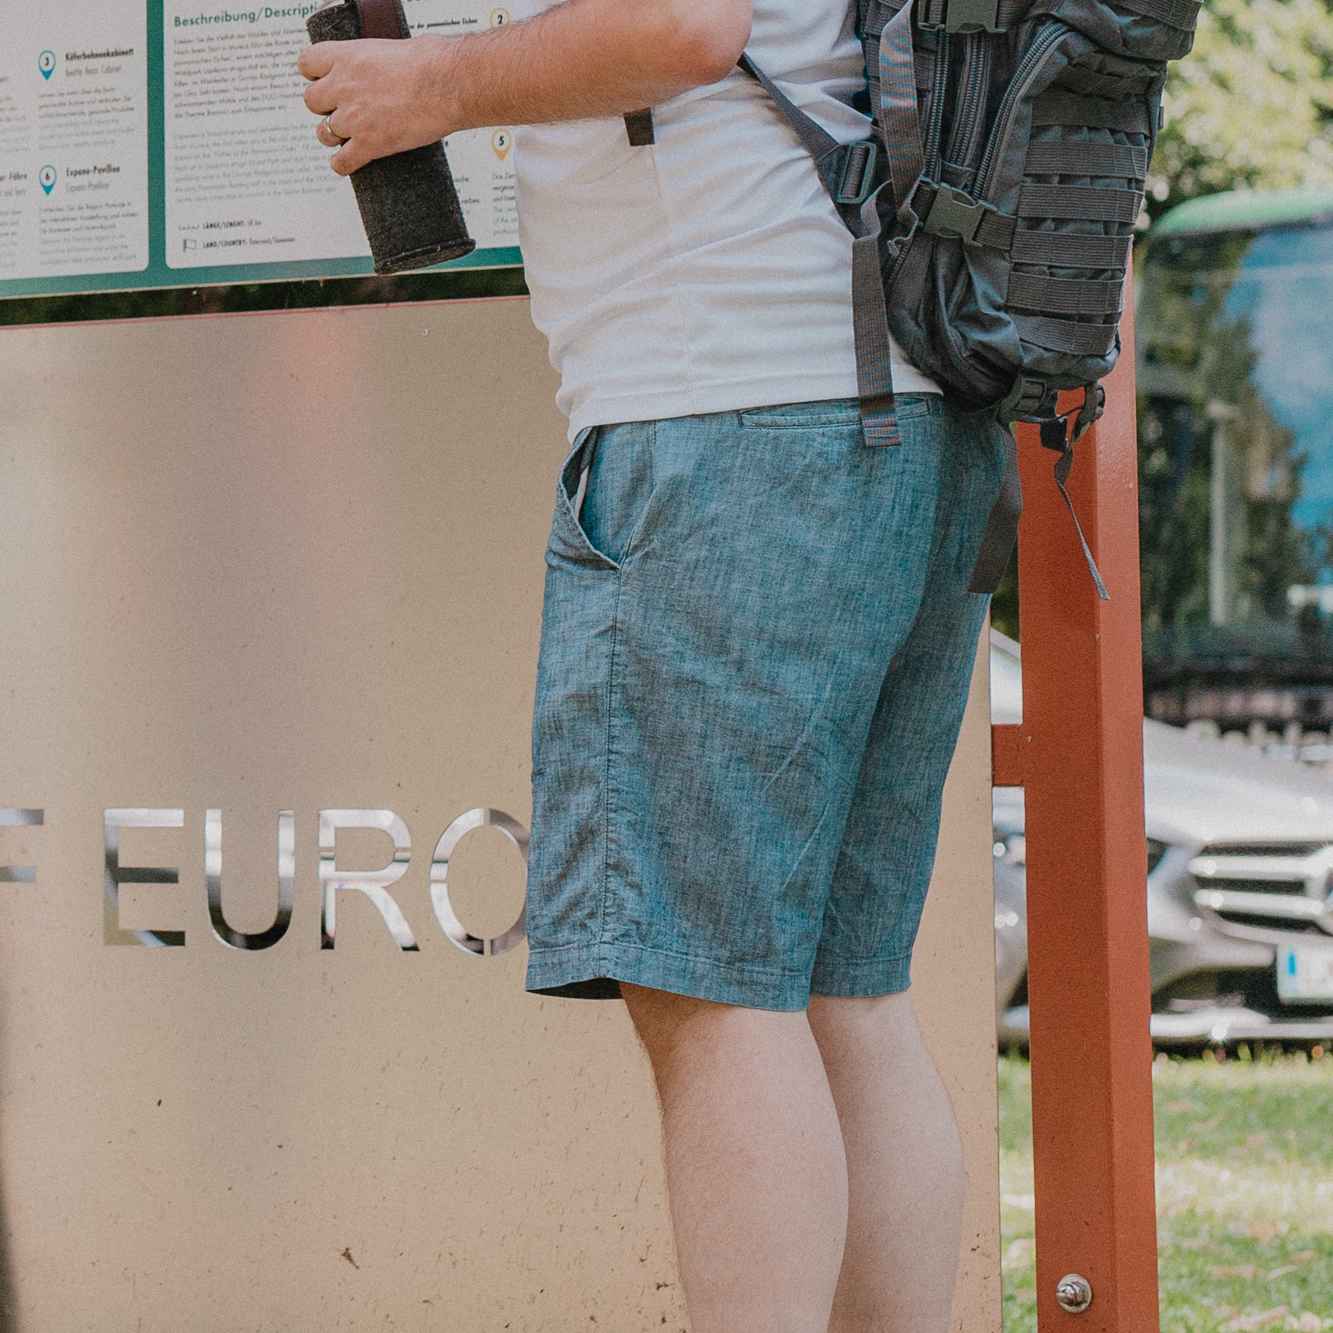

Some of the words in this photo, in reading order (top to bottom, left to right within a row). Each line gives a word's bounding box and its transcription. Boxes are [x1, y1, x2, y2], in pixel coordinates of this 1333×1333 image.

[497, 15, 504, 24] 2
[45, 56, 50, 67] 3
[499, 136, 504, 146] 5
[45, 172, 50, 181] 6
